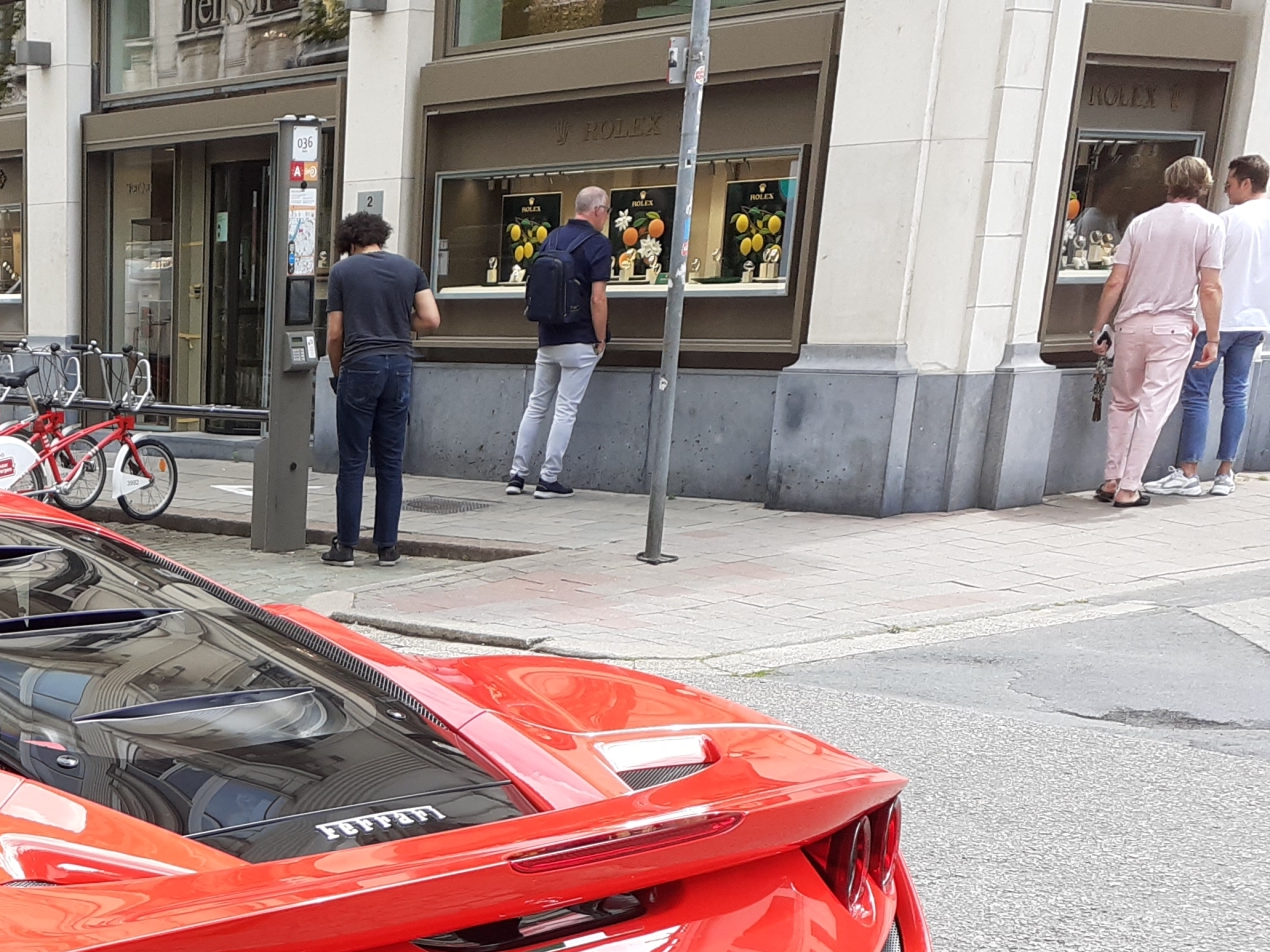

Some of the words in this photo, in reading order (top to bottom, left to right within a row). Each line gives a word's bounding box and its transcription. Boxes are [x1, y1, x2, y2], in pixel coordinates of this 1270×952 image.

[1088, 83, 1159, 109] ROLEX
[584, 115, 661, 142] ROLEX
[297, 136, 313, 149] 036
[367, 196, 373, 207] 2
[750, 193, 774, 201] ROLEX
[315, 805, 446, 840] Ferrari
